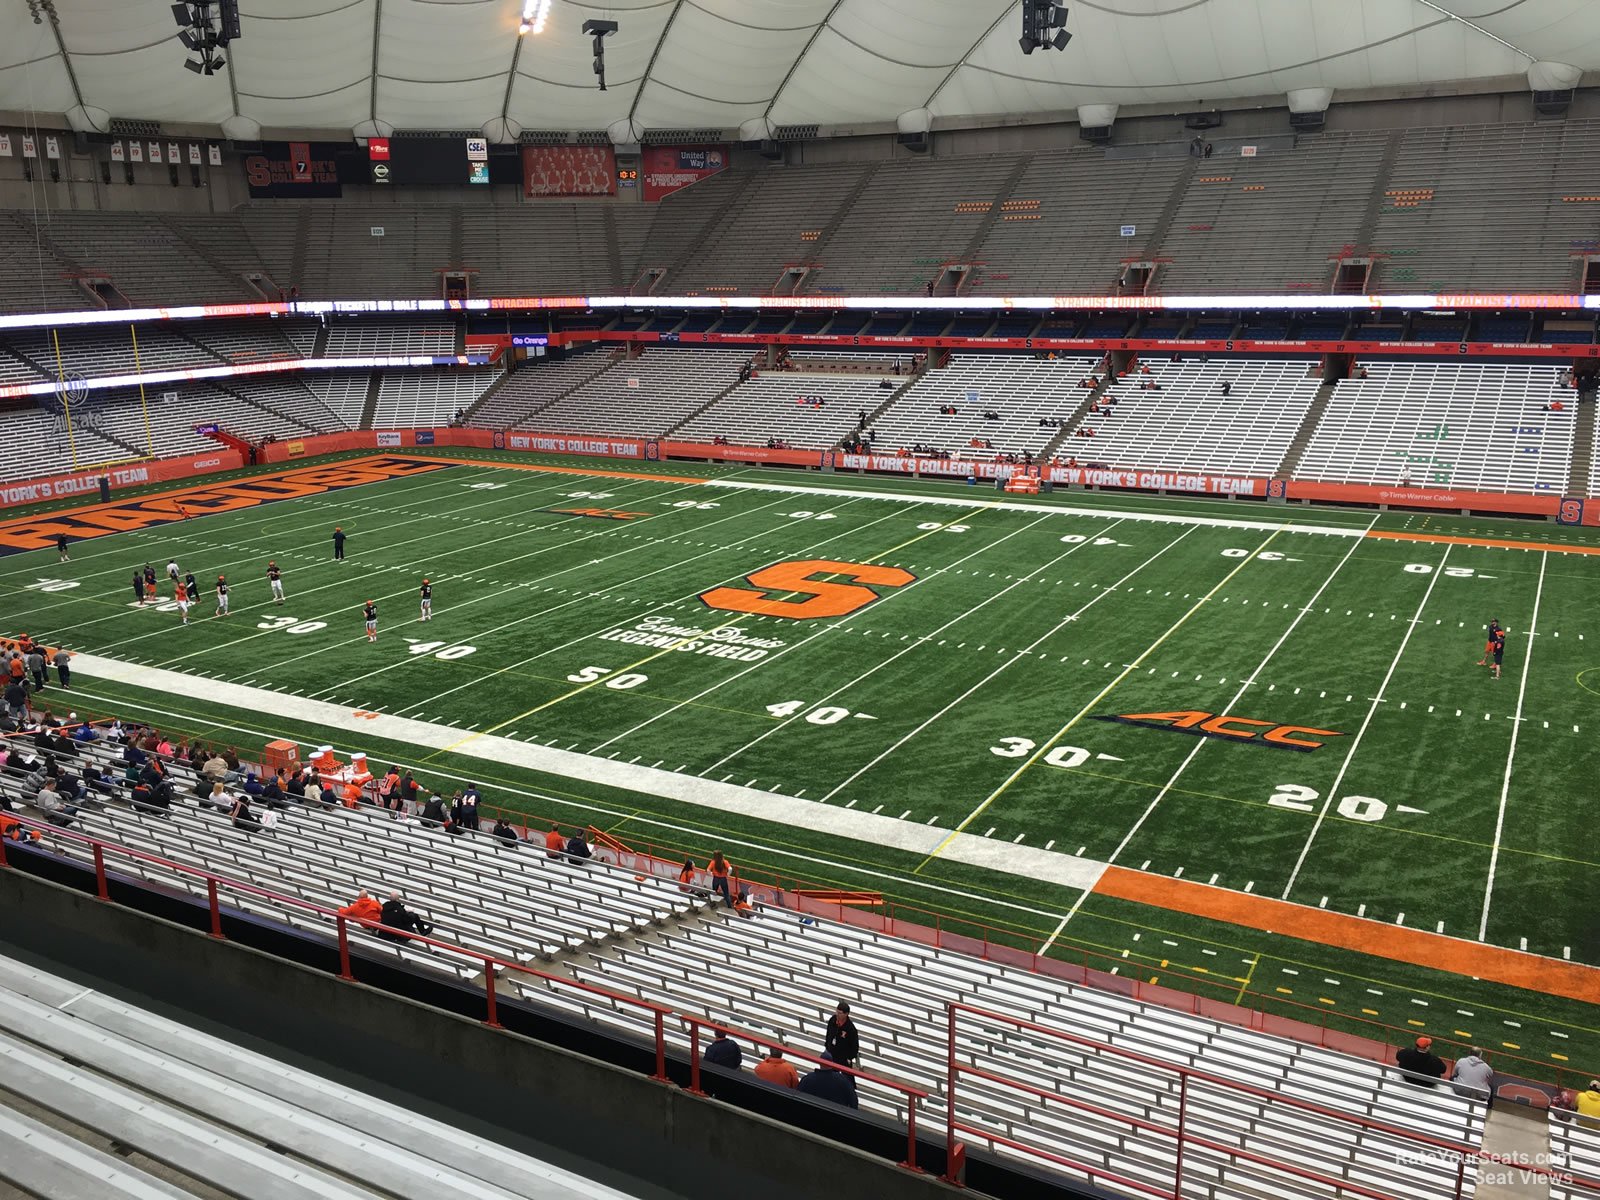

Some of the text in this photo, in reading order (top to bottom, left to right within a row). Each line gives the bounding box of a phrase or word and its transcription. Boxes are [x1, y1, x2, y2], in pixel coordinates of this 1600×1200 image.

[24, 143, 34, 152] 30
[50, 145, 56, 153] 4
[112, 148, 122, 156] 44
[681, 152, 705, 160] United
[298, 162, 305, 173] 7
[690, 160, 705, 169] Way
[620, 171, 637, 179] 10:12
[491, 299, 540, 309] SYRACUSE
[759, 298, 803, 309] SYRACUSE
[1054, 297, 1163, 308] SYRACUSE FOOTBALL
[1435, 296, 1506, 307] SYRACUSE
[513, 336, 524, 345] Go
[1025, 338, 1032, 348] S
[1226, 340, 1233, 350] S
[1459, 344, 1468, 354] S
[52, 411, 103, 435] Allstate
[494, 432, 504, 448] S
[511, 436, 638, 456] NEW YORK'S COLLEGE TEAM
[647, 443, 658, 459] S
[193, 458, 221, 469] GEICO
[823, 453, 833, 466] S
[843, 454, 870, 468] NEW
[872, 456, 914, 471] YORK'S
[919, 459, 974, 475] COLLEGE
[0, 481, 51, 504] YORK'S
[115, 467, 149, 485] TEAM
[1050, 467, 1254, 495] NEW YORK'S COLLEGE TEAM
[1269, 480, 1283, 497] S
[1388, 490, 1406, 499] Time
[789, 510, 838, 520] 40
[1561, 499, 1581, 523] S
[916, 521, 974, 533] 50
[1060, 534, 1119, 547] 40
[1219, 547, 1291, 562] 30
[1403, 562, 1476, 578] 20
[696, 558, 919, 620] S
[257, 616, 328, 634] 30
[635, 615, 787, 648] Ernie Davis
[407, 641, 477, 662] 40
[599, 629, 769, 662] LEGENDS FIELD
[567, 666, 649, 689] 50
[766, 700, 851, 725] 40
[1117, 709, 1346, 749] ACC
[990, 736, 1091, 768] 30
[1267, 783, 1388, 822] 20
